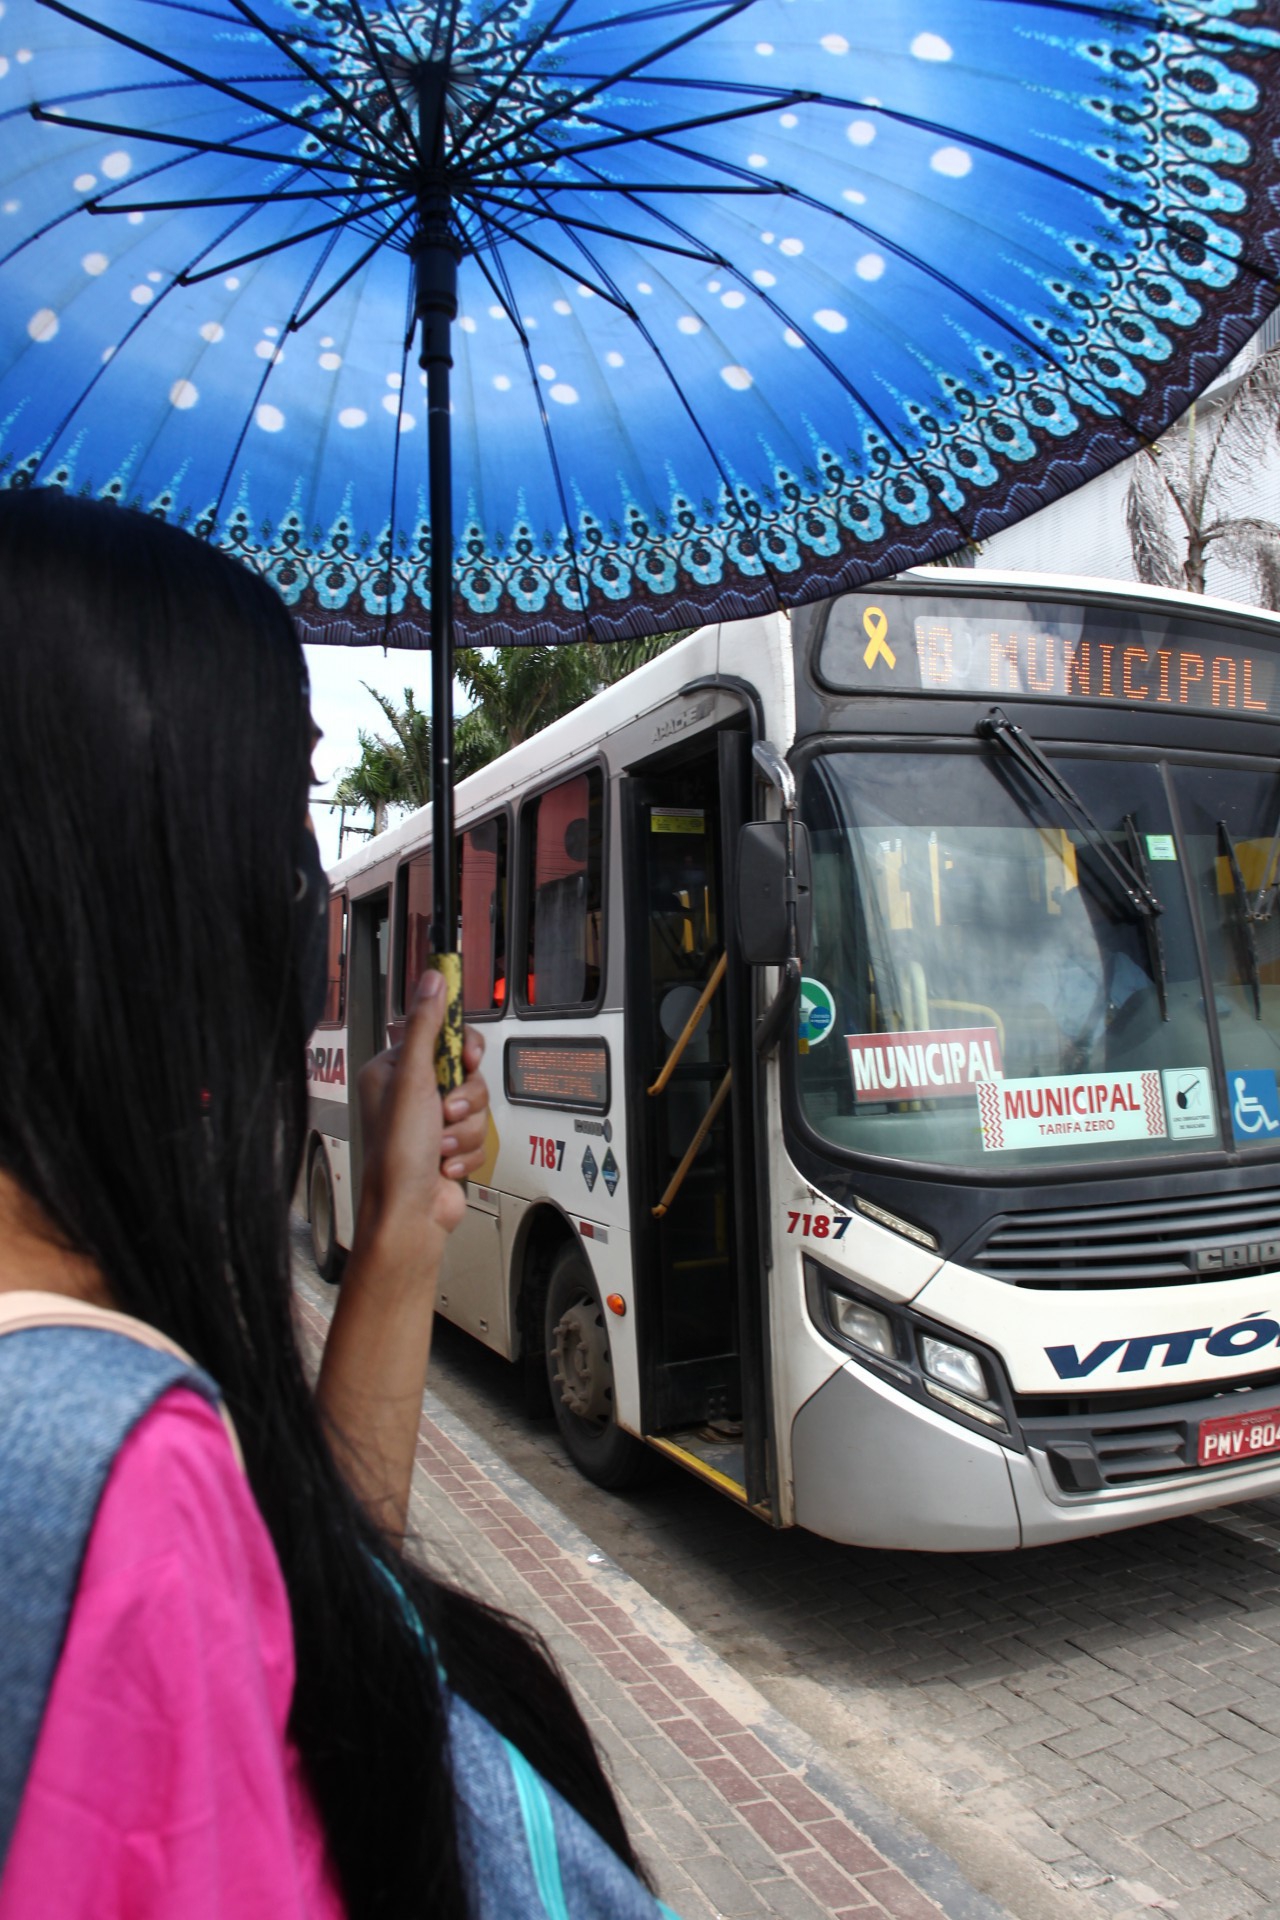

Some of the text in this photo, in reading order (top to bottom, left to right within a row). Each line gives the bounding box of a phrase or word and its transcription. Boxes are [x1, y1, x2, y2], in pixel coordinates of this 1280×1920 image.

[990, 632, 1268, 710] MUNICIPAL
[851, 1040, 1003, 1091] MUNICIPAL
[1004, 1083, 1141, 1119] MUNICIPAL
[1039, 1119, 1116, 1135] TARIFA ZERO
[529, 1136, 566, 1171] 7187
[787, 1211, 852, 1239] 7187
[1044, 1310, 1280, 1379] VITÓ
